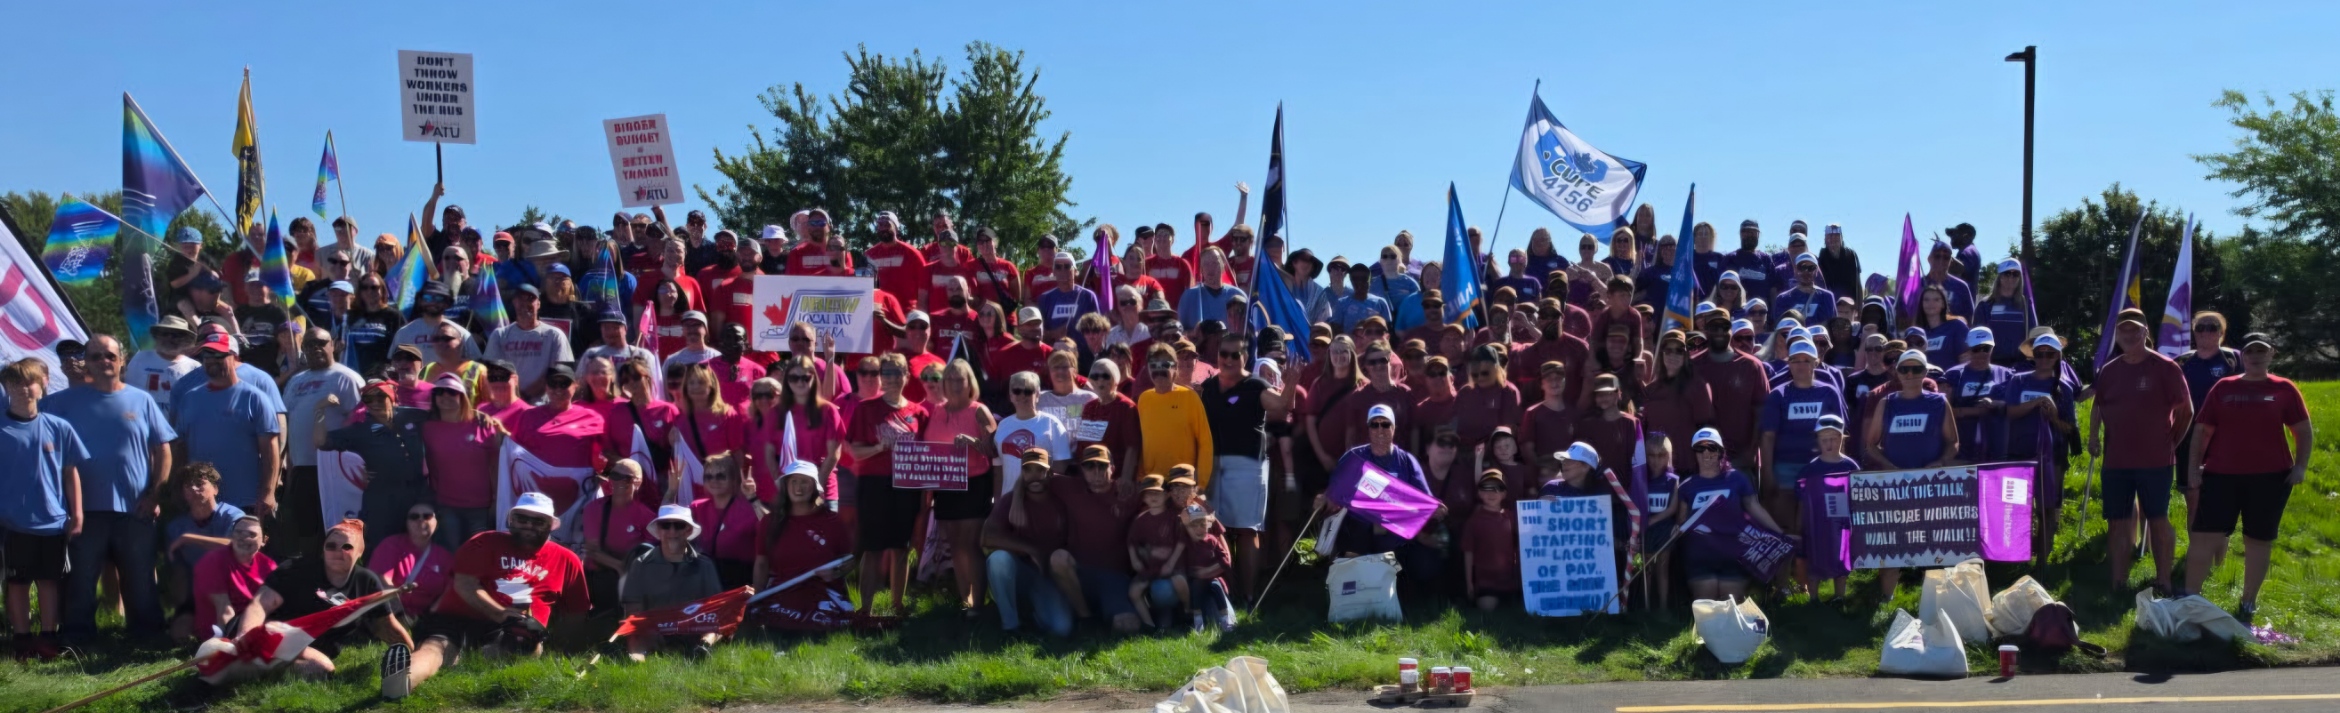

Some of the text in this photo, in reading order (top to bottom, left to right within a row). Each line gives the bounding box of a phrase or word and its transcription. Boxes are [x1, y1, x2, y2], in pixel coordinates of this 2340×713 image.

[417, 56, 454, 67] DON'T
[414, 68, 458, 79] THROW
[406, 79, 468, 93] WORKERS
[416, 92, 458, 103] UNDER
[413, 104, 435, 115] THE
[433, 126, 460, 138] ATU
[614, 120, 656, 133] BIGGER
[1542, 177, 1593, 213] 4156
[1895, 418, 1922, 428] SEIU
[1883, 485, 1910, 501] TALK
[1912, 483, 1934, 499] THE
[1550, 499, 1603, 515] CUTS,
[1924, 505, 1979, 522] WORKERS
[1547, 516, 1607, 532] SHORT
[1532, 533, 1610, 548] STAFFING,
[1866, 531, 1896, 545] WALK
[1905, 530, 1926, 544] THE
[1524, 547, 1595, 561] THE LACK
[1537, 565, 1558, 578] OF
